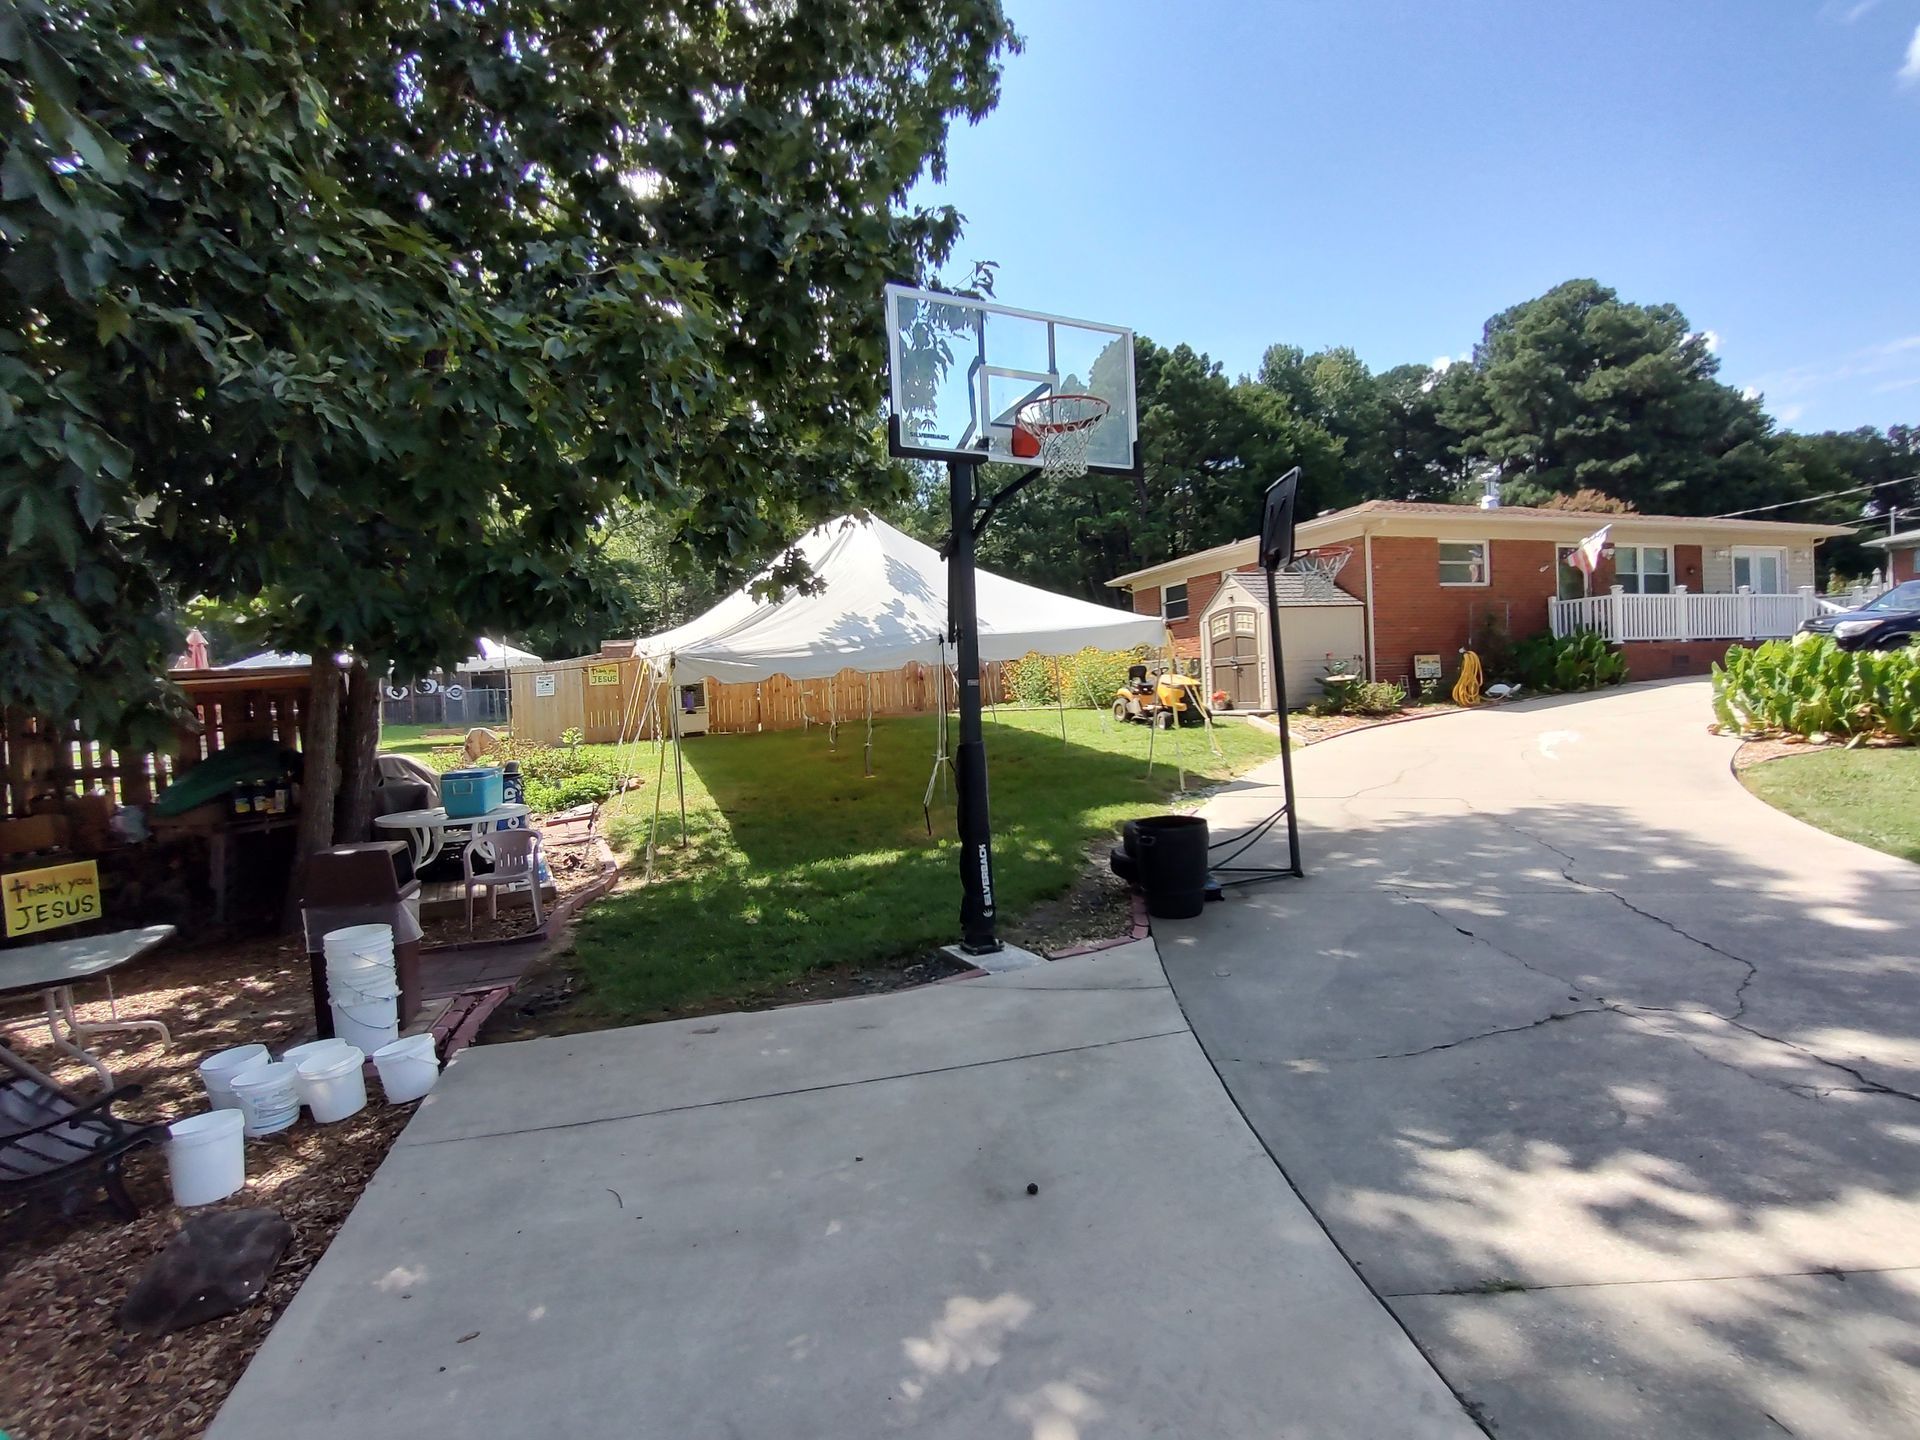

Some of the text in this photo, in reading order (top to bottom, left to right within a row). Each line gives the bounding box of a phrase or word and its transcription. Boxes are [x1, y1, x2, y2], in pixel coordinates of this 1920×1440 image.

[910, 432, 949, 440] SILVERBACK
[591, 675, 617, 684] JESUS
[978, 844, 992, 906] SILVERBACK
[68, 878, 93, 895] you
[15, 895, 94, 930] JESUS
